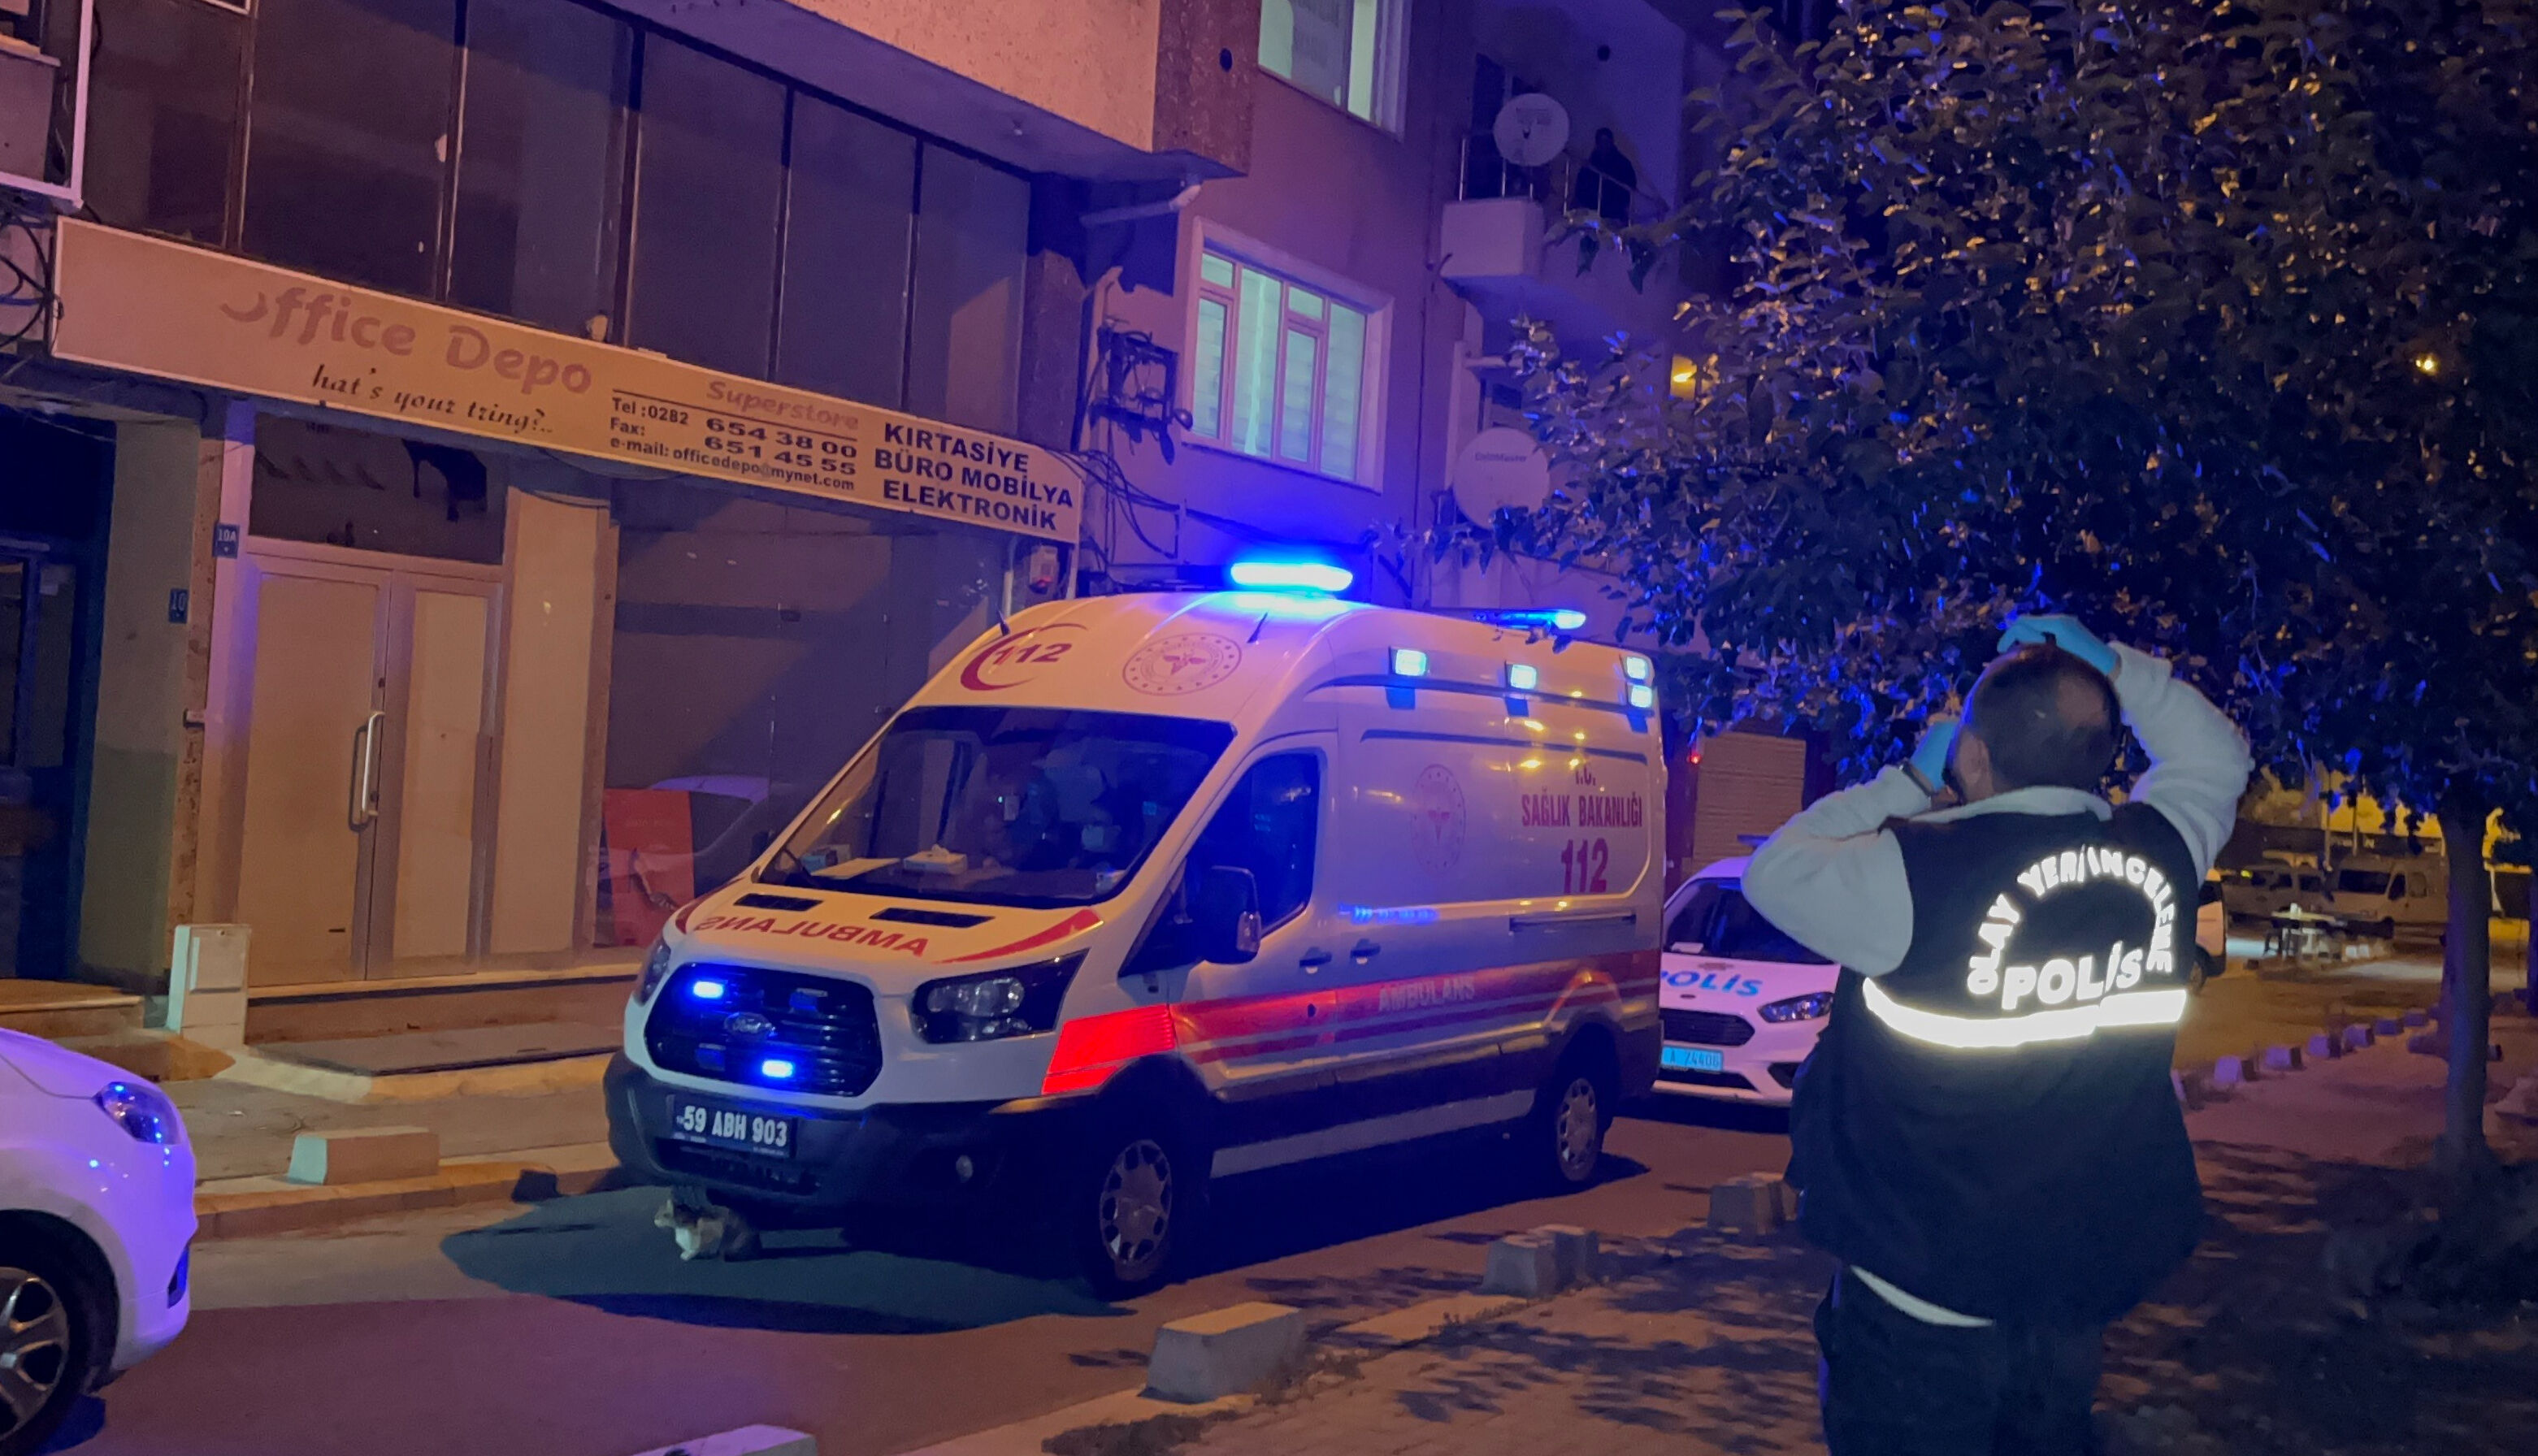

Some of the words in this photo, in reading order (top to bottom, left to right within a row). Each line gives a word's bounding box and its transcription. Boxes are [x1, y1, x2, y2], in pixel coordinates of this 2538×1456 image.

[445, 325, 592, 395] Depo
[612, 396, 636, 414] Tel
[706, 418, 767, 440] 654
[775, 431, 813, 449] 38
[822, 441, 857, 458] 00
[706, 380, 859, 431] Superstore
[610, 416, 646, 436] Fax:
[705, 436, 761, 458] 651
[774, 451, 813, 466] 45
[821, 458, 856, 474] 55
[610, 437, 669, 457] e-mail:
[884, 422, 1030, 474] KIRTASİYE
[874, 448, 953, 482] BÜRO
[961, 466, 1074, 509] MOBİLYA
[883, 479, 1057, 531] ELEKTRONİK
[218, 530, 236, 543] 10A
[172, 592, 186, 612] 10
[992, 643, 1073, 665] 112
[1521, 788, 1571, 827] SAĞLIK
[1578, 791, 1642, 827] BAKANLIĞI
[1561, 838, 1609, 894] 112
[1967, 894, 2020, 995] OLAY
[1378, 976, 1476, 1012] AMBULANS
[683, 1106, 707, 1133] 59
[712, 1111, 747, 1140] ABH
[752, 1116, 787, 1147] 903
